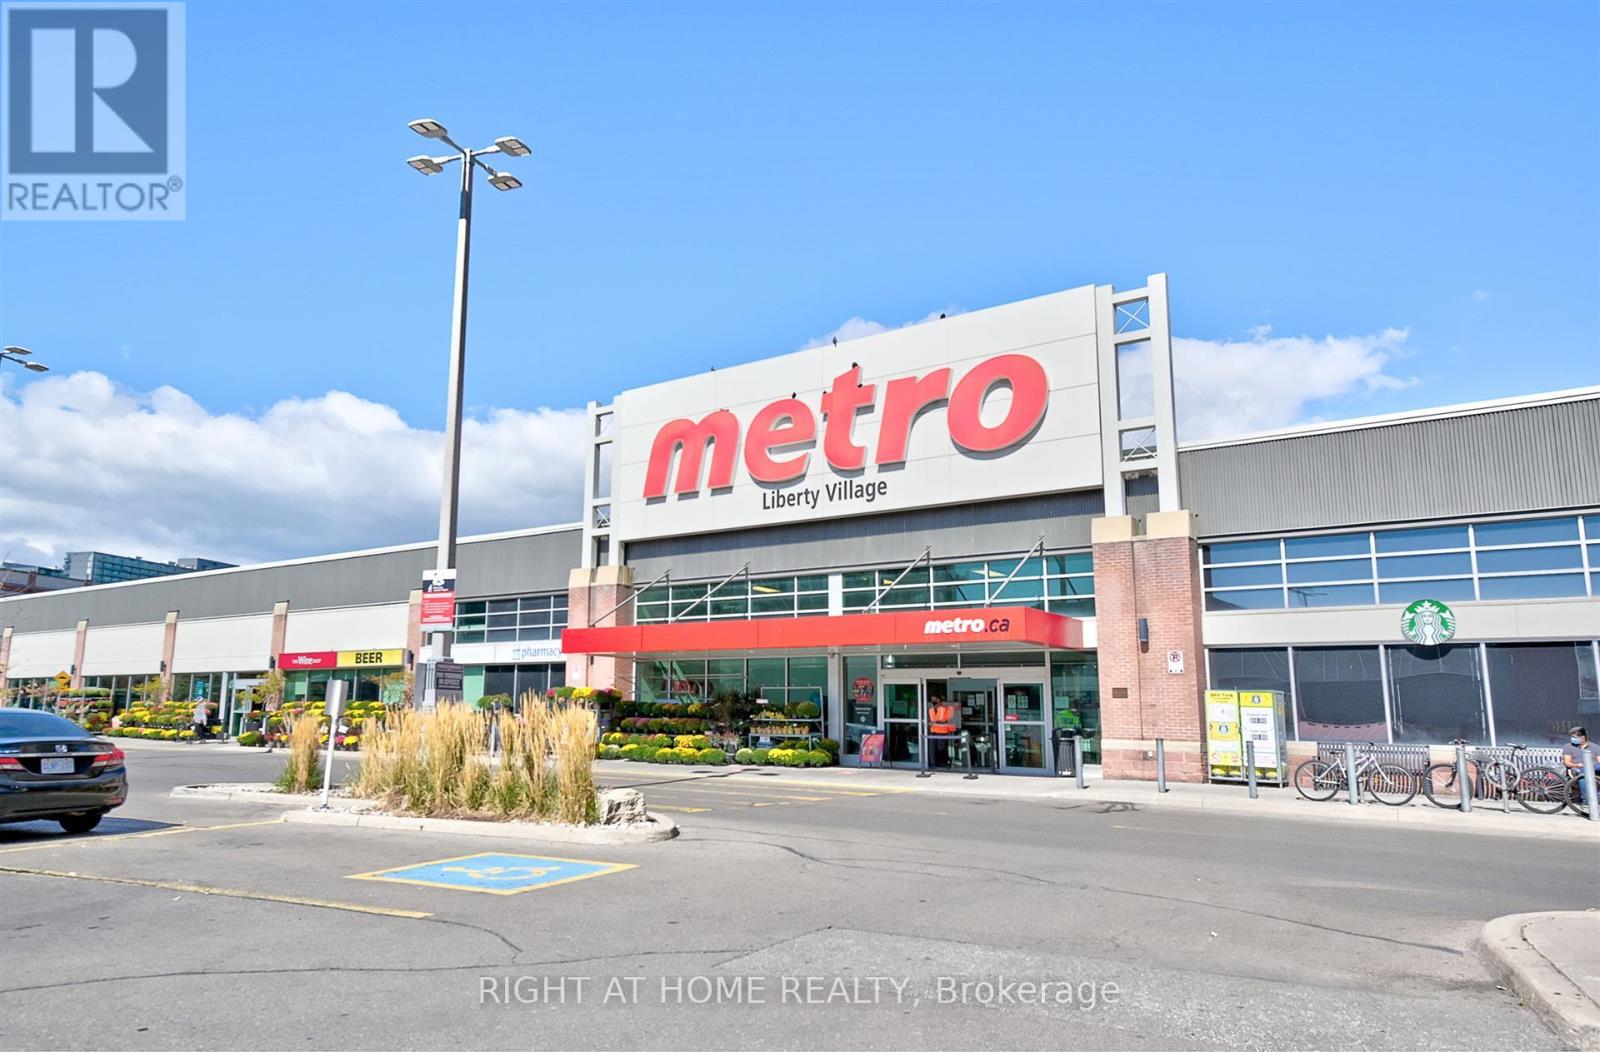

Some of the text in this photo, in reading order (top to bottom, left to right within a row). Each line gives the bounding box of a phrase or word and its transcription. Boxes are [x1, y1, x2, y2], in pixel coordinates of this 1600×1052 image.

[642, 353, 1050, 499] metro
[762, 478, 888, 510] Liberty Village
[924, 617, 1010, 635] metro.ca
[355, 652, 383, 664] BEER
[521, 645, 562, 661] pharmacy
